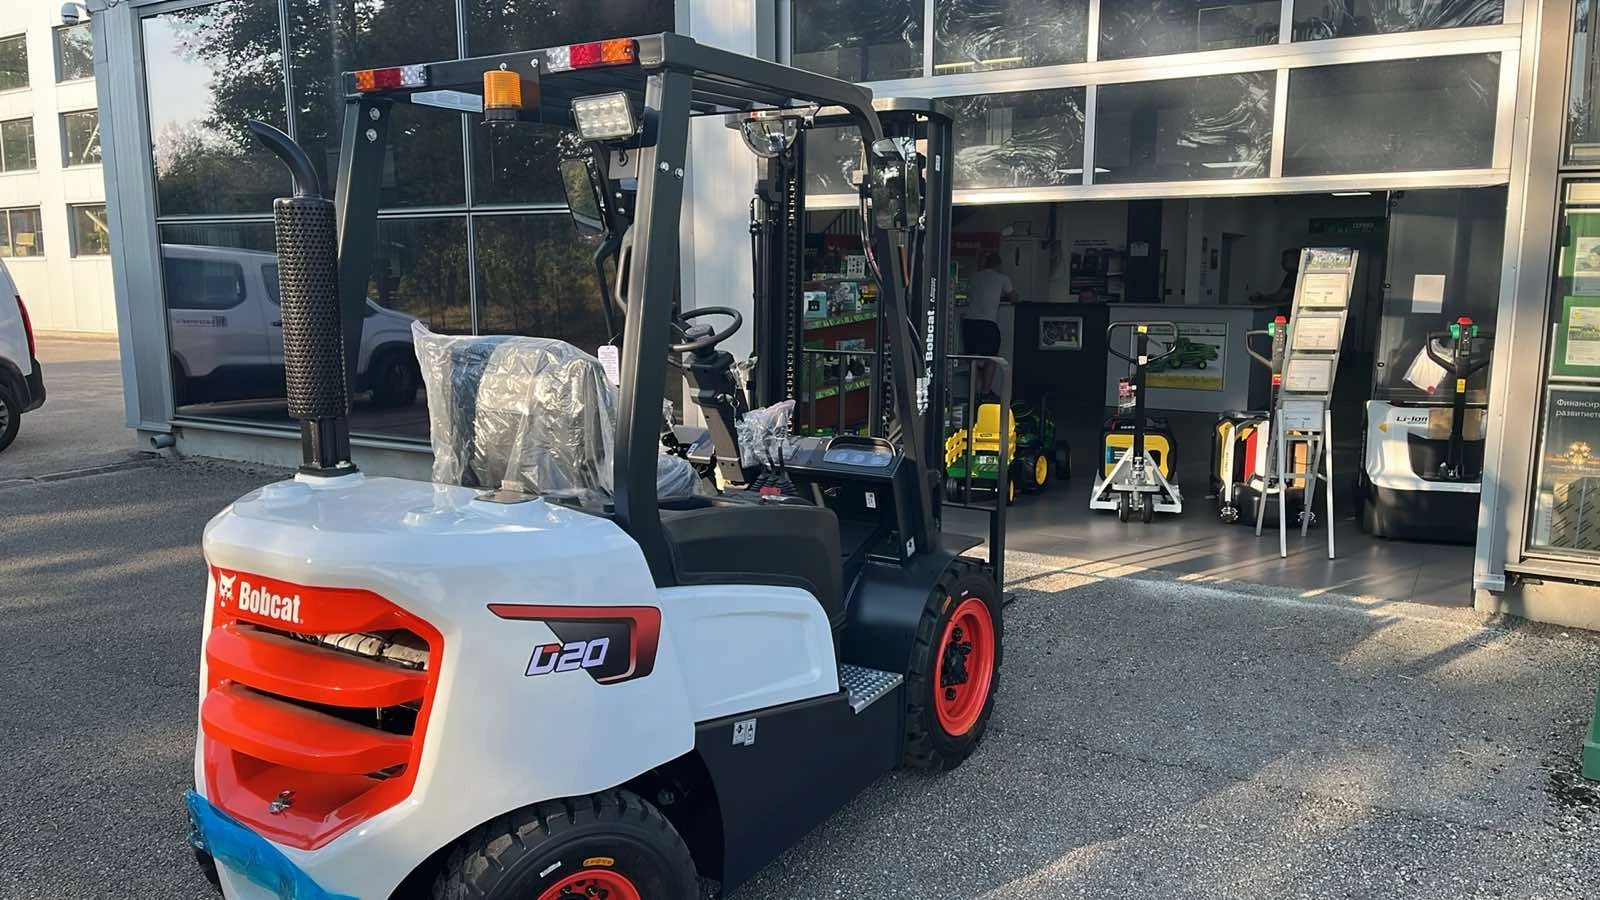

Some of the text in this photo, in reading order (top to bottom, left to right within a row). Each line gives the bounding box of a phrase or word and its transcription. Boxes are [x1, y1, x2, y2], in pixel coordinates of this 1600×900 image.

[926, 310, 935, 361] Bobcat
[1556, 398, 1600, 409] Финансир
[238, 580, 302, 624] Bobcat
[525, 636, 610, 677] D20
